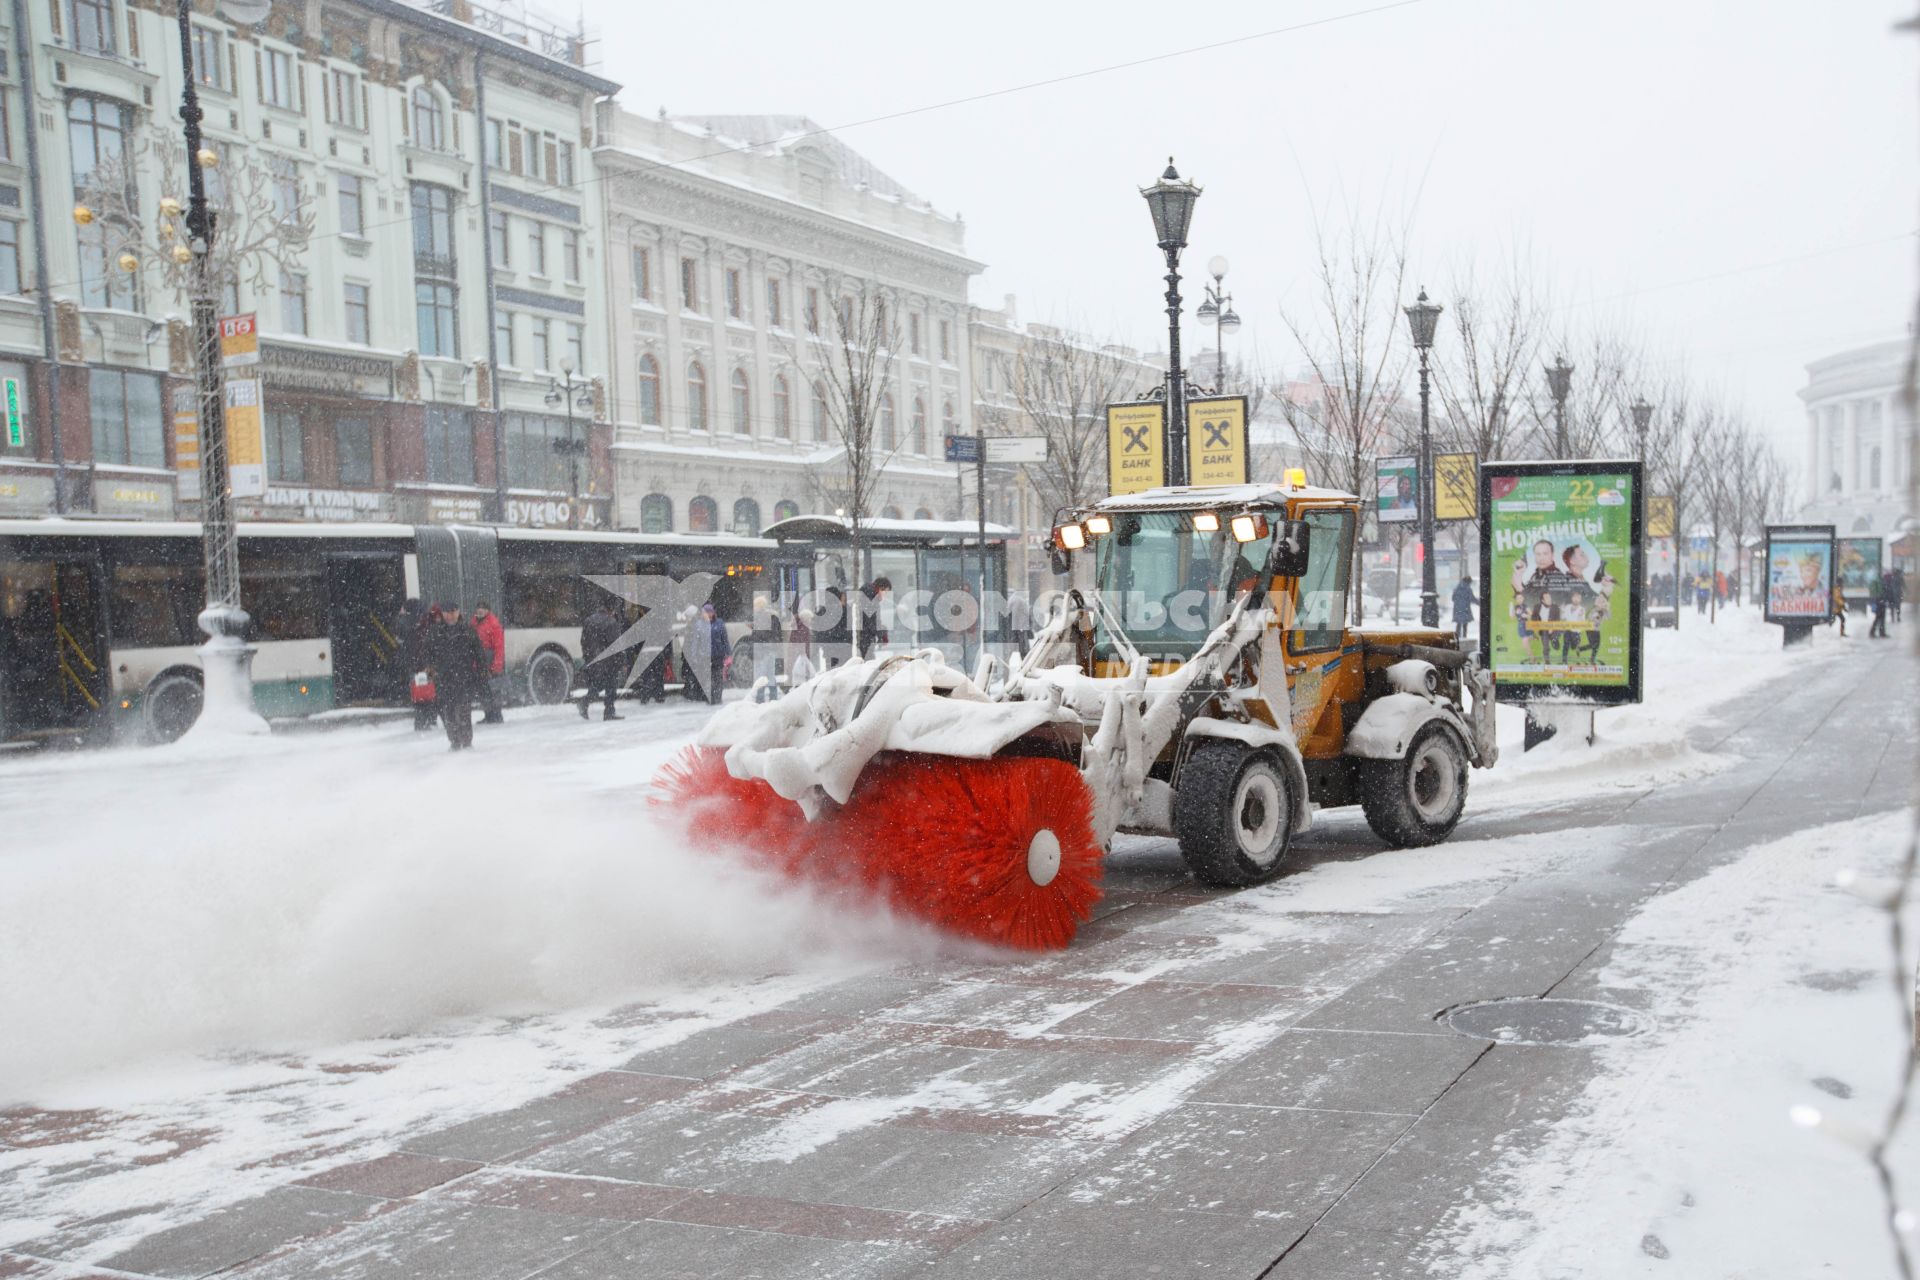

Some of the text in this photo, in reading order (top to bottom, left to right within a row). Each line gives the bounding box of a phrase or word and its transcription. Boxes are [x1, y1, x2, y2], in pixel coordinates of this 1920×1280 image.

[1121, 458, 1152, 469] БАНК
[1202, 454, 1233, 465] БАНК
[1568, 479, 1595, 500] 22
